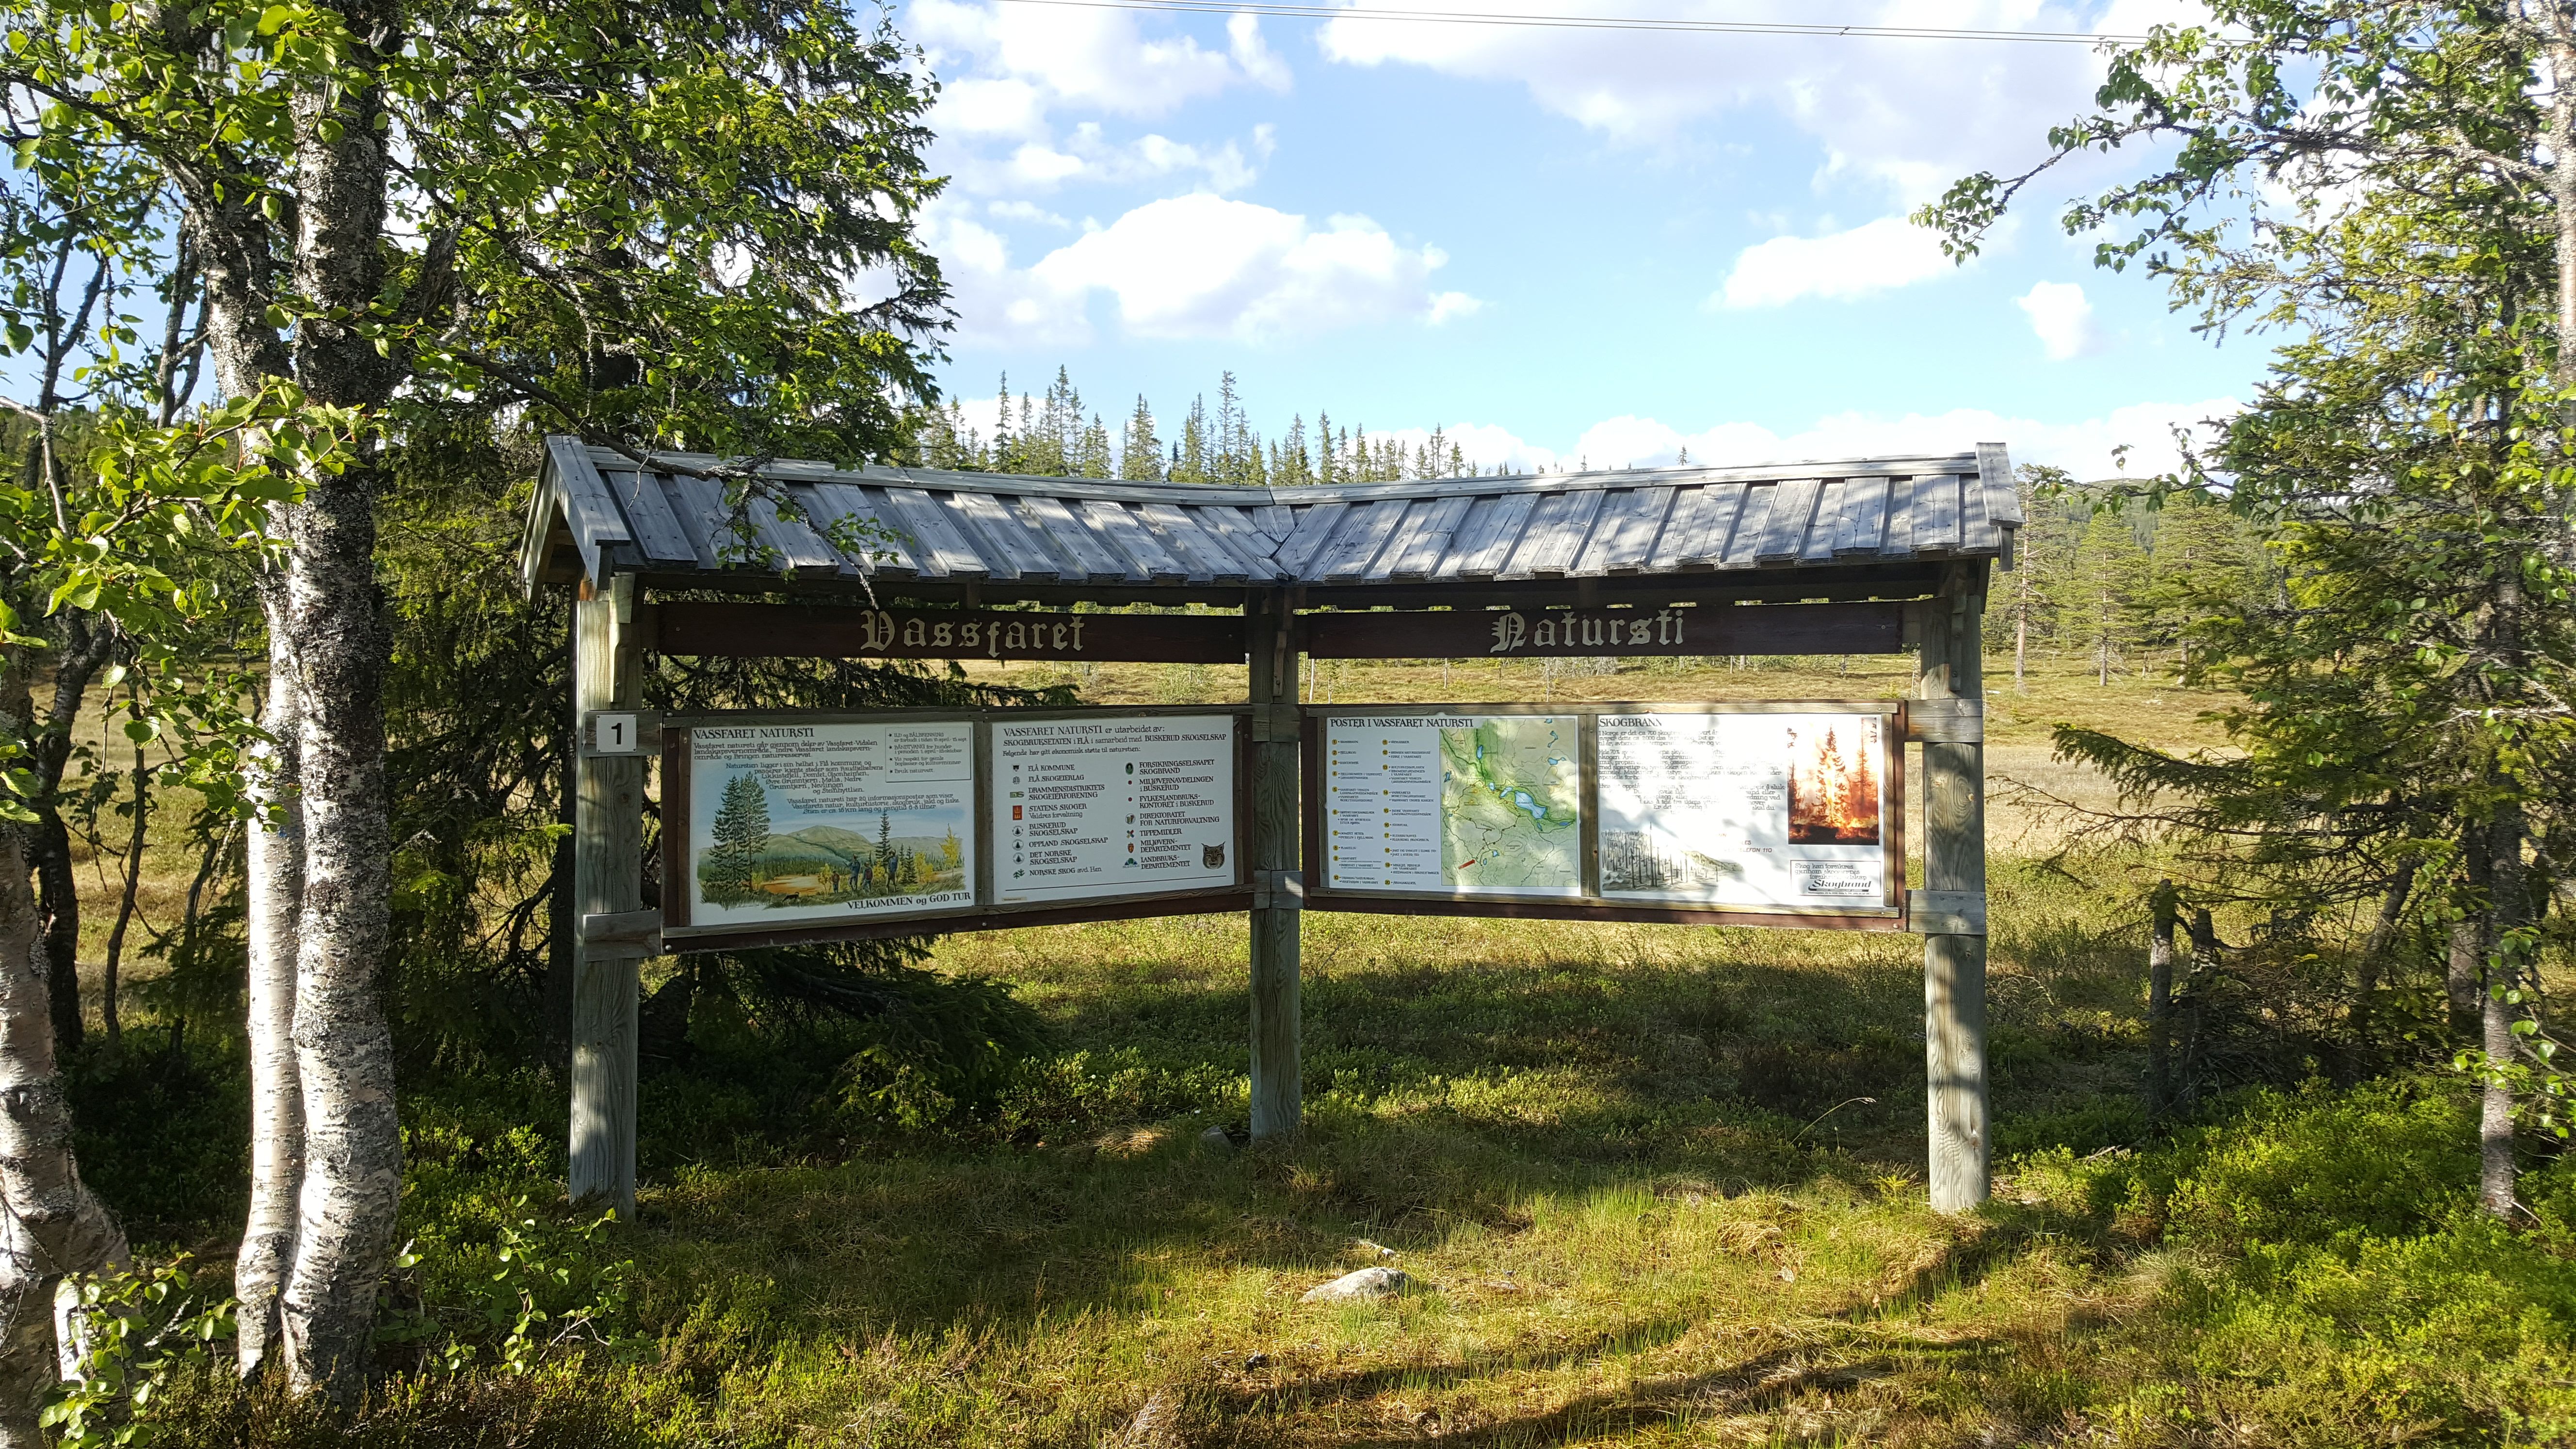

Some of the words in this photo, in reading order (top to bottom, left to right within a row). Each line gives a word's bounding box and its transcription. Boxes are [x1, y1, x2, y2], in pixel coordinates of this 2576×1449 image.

[1490, 609, 1684, 653] Natursti
[1330, 719, 1365, 728] POSTER
[1368, 719, 1371, 727] I
[1373, 719, 1424, 729] VASSFARET
[1426, 719, 1473, 728] NATURSTI
[1599, 718, 1662, 727] SKOGBRANN
[612, 723, 622, 744] 1
[694, 729, 756, 739] VASSFARET
[760, 727, 815, 738] NATURSTI
[1003, 727, 1054, 737] VASSFARET
[1058, 725, 1103, 735] NATURSTI
[1115, 725, 1152, 733] utarbeidet
[1003, 738, 1072, 746] SKOGBRUKSETATEN
[1077, 736, 1089, 745] FLÅ
[1144, 734, 1180, 742] BUSKERUD
[1003, 749, 1027, 757] Følgende
[1028, 764, 1039, 772] FLÅ
[1140, 759, 1214, 769] FORSIKRINGSSELSKAPET
[1139, 776, 1214, 786] MILJØVERNAVDELINGEN
[1028, 784, 1105, 794] DRAMMENSDISTRIKTETS
[1029, 791, 1098, 801] SKOGEIERFORENING
[1140, 794, 1201, 802] FYLKESLANDBRUKS-
[1179, 799, 1215, 807] BUSKERUD
[1140, 811, 1186, 820] DIREKTORATET
[1029, 822, 1066, 830] BUSKERUD
[1155, 816, 1220, 826] NATURFORVALTNING
[1029, 828, 1078, 837] SKOGSELSKAP
[1140, 828, 1182, 837] TIPPEMIDLER
[1029, 840, 1058, 848] OPPLAND
[1060, 837, 1109, 846] SKOGSELSKAP
[1141, 838, 1178, 847] MILJØVERN-
[1141, 844, 1191, 853] DEPARTEMENTET
[1044, 850, 1072, 858] NORSKE
[1141, 855, 1179, 863] LANDBRUKS-
[1030, 856, 1078, 866] SKOGSELSKAP
[1141, 860, 1191, 869] DEPARTEMENTET
[1812, 879, 1872, 889] Skogbrand
[848, 897, 913, 910] VELKOMMEN
[916, 897, 927, 905] og
[929, 894, 950, 903] GOD
[952, 892, 971, 901] TUR
